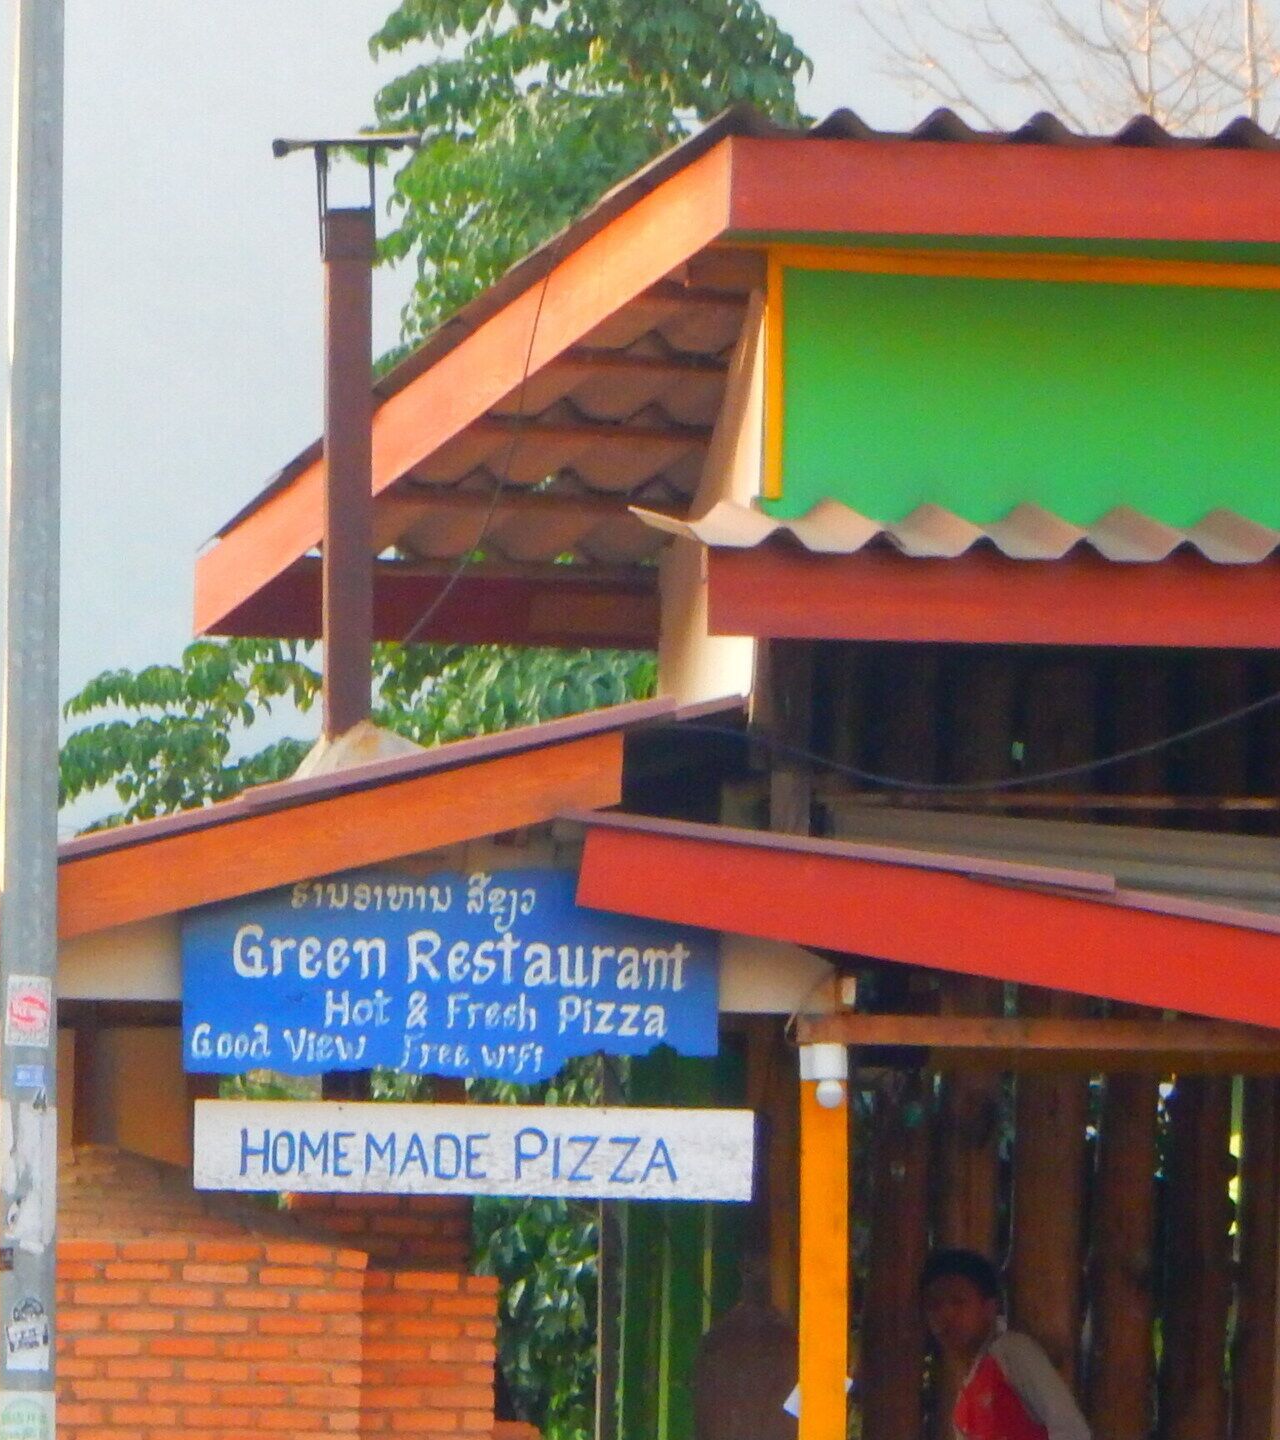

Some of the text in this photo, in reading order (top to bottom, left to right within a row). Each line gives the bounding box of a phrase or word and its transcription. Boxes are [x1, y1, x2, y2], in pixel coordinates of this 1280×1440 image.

[233, 924, 690, 992] Green Restaurant
[323, 988, 668, 1039] Hot & Fresh Pizza
[191, 1022, 272, 1060] Good
[400, 1033, 470, 1070] Free
[514, 1126, 679, 1183] PIZZA
